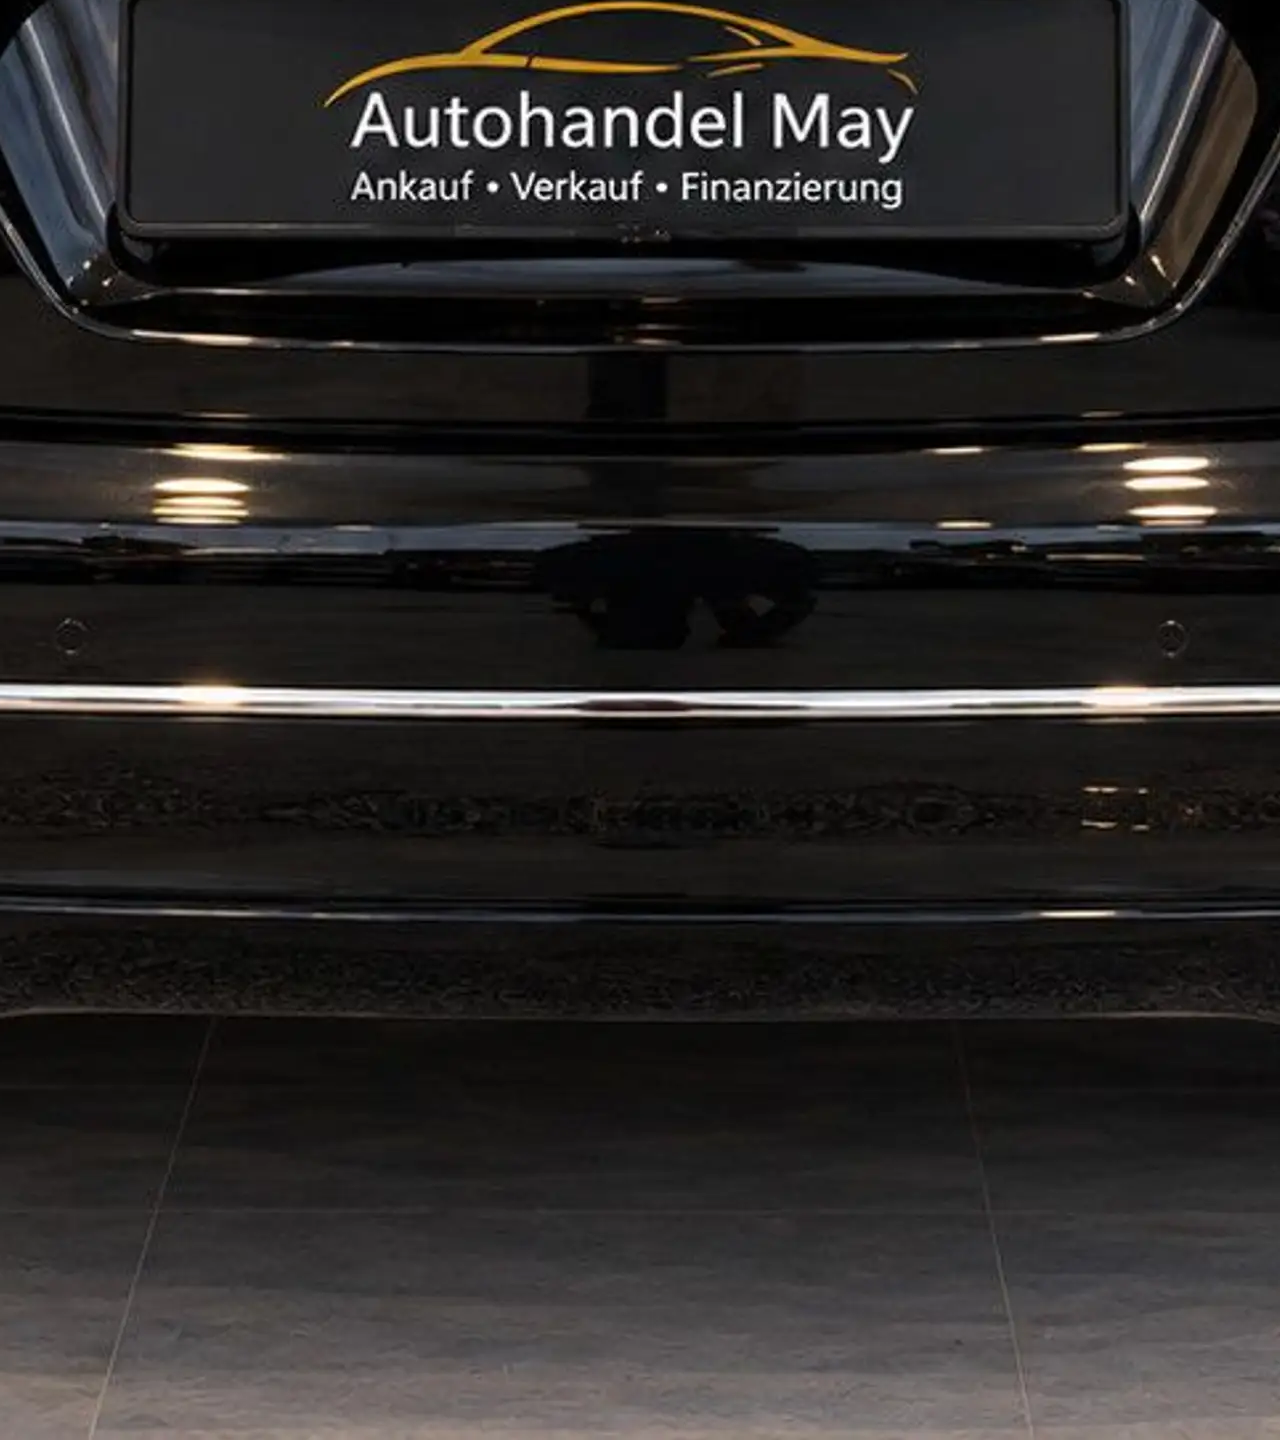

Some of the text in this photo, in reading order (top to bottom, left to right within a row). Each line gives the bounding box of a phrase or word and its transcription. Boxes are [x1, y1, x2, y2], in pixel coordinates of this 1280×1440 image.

[350, 89, 915, 165] Autohandel May
[349, 169, 904, 210] Ankauf Verkauf Finanzierung
